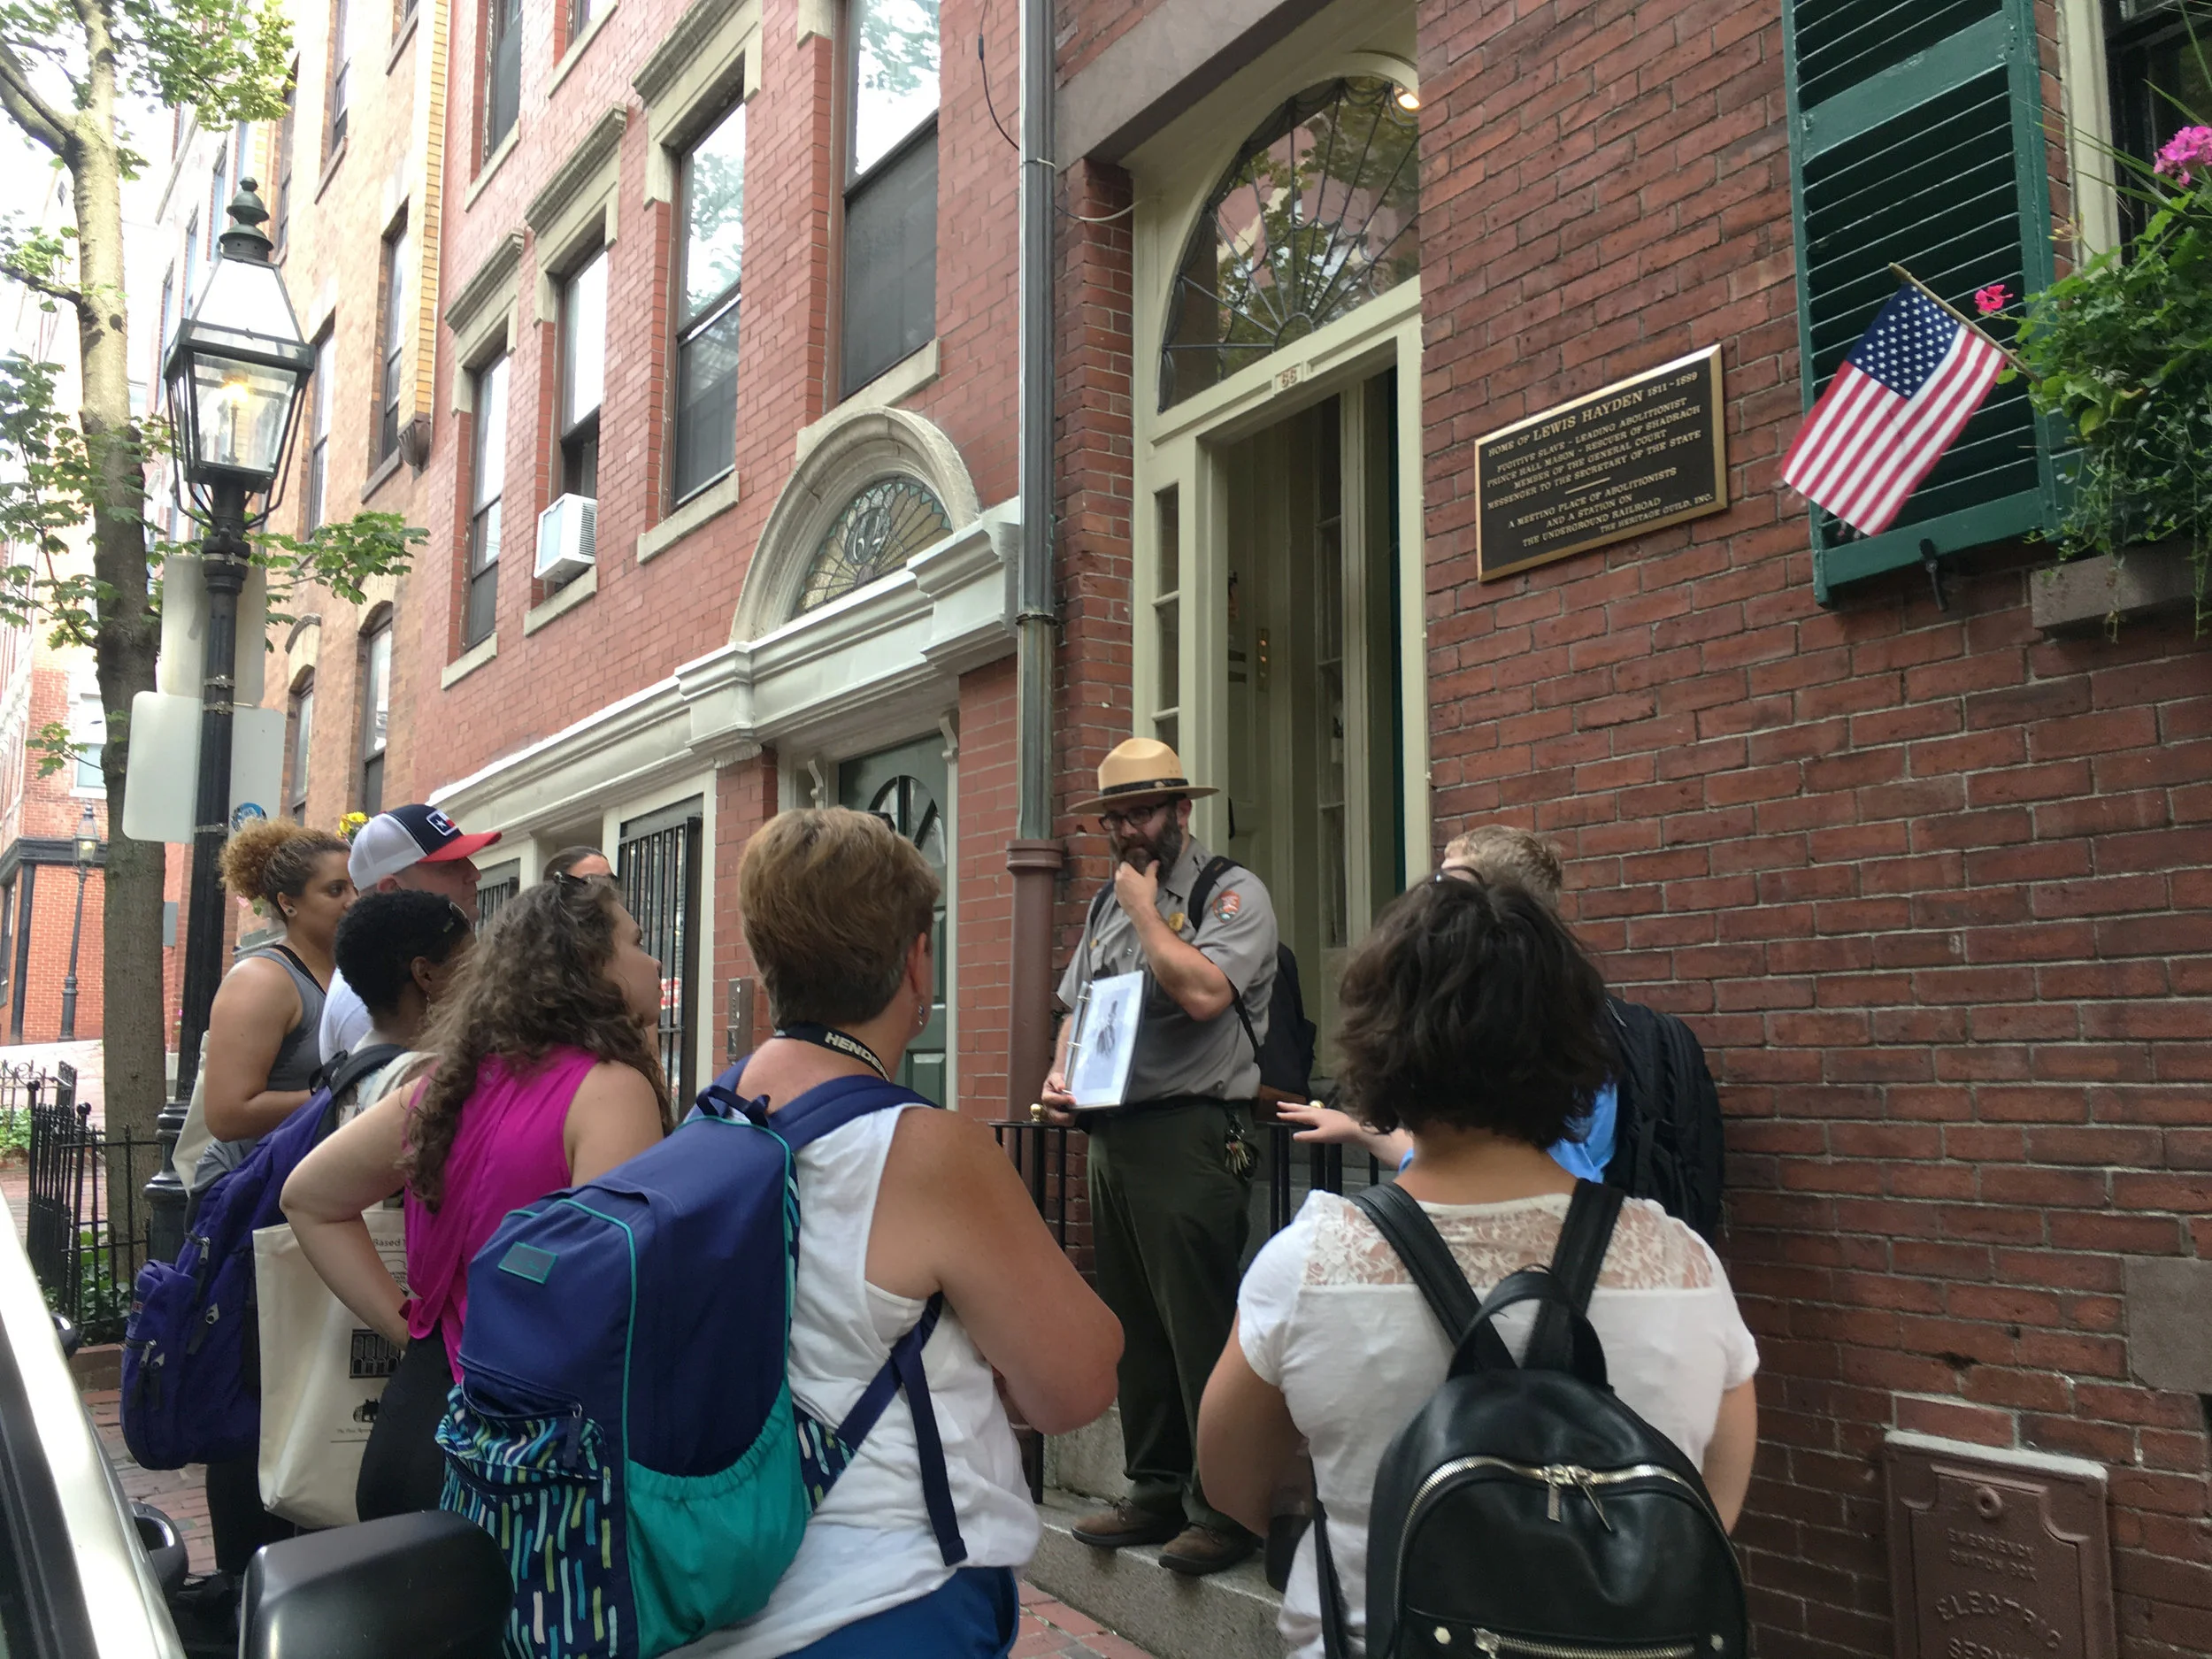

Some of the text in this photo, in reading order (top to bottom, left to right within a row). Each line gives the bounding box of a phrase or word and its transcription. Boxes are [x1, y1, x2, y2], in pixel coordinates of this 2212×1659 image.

[1486, 471, 1517, 488] PRINCE
[1519, 462, 1543, 476] HALL
[1545, 449, 1575, 466] MASON
[1585, 431, 1627, 452] RESCUER
[1630, 425, 1643, 436] OF
[1645, 404, 1701, 431] SHADRACH
[1488, 441, 1515, 457] HOME
[1517, 434, 1531, 446] OF
[1532, 415, 1576, 441] LEWIS
[1582, 390, 1643, 422] HAYDEN
[1497, 452, 1536, 473] FUGITIVE
[1538, 442, 1565, 457] SLAVE
[1575, 423, 1616, 444] LEADING
[1619, 397, 1687, 428] ABOLITIONIST
[1487, 429, 1701, 511] MESSENGER TO THE SECRETARY OF THE STATE
[1514, 429, 1667, 489] MEMBER OF THE GENERAL COURT
[1508, 466, 1678, 529] A MEETING PLACE OF ABOLITIONISTS
[1522, 497, 1662, 547] THE UNDERGROUND RAILROAD
[1546, 516, 1565, 528] AND
[1578, 499, 1616, 518] STATION
[1618, 494, 1632, 504] ON
[1600, 523, 1616, 533] THE
[1617, 509, 1660, 527] HERITAGE
[1694, 493, 1713, 504] INC.
[1935, 1589, 2064, 1651] ELECTRIC
